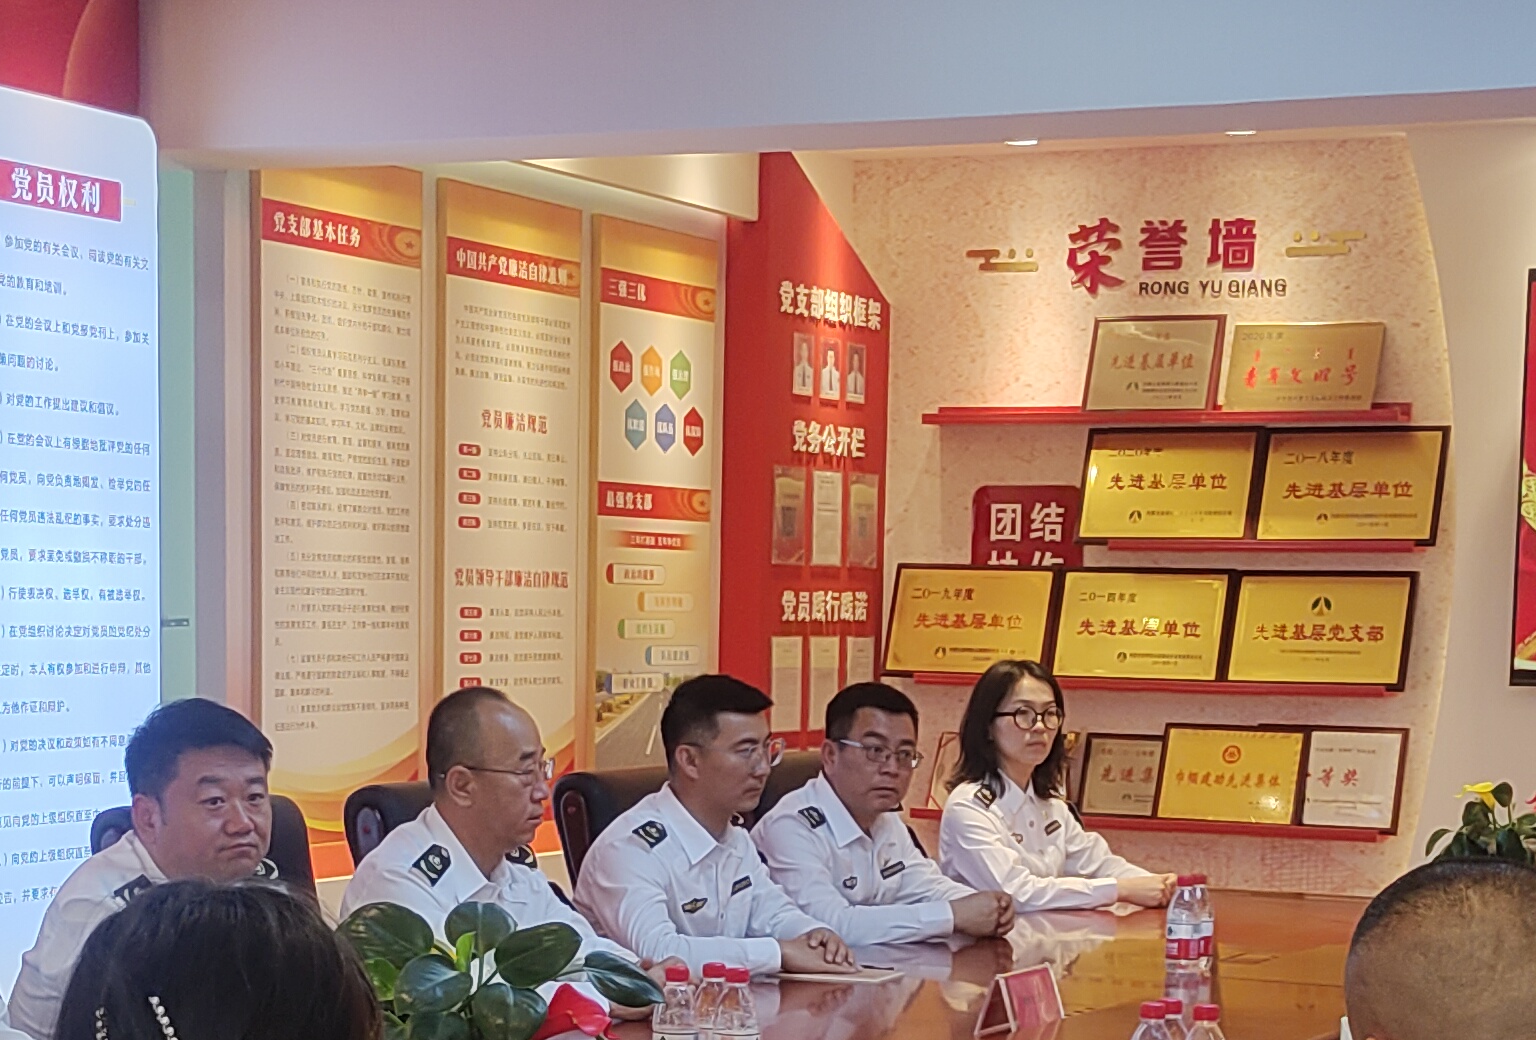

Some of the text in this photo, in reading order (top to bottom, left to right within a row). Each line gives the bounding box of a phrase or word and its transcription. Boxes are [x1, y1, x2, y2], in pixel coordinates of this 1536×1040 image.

[11, 167, 100, 213] 党员权利
[274, 212, 360, 247] 党支部基本任务
[1067, 218, 1257, 295] 荣誉墙
[1139, 279, 1288, 298] RONG YU QIANG
[779, 281, 881, 330] 党支部组织框架
[792, 420, 865, 458] 党务公开栏
[1108, 473, 1227, 490] 先进基层单位
[1283, 481, 1413, 499] 先进基层单位
[990, 503, 1065, 541] 团结
[915, 613, 1022, 629] 先进基层单位
[1077, 618, 1201, 638] 先进基层单位
[1253, 623, 1385, 643] 先进基层党支部
